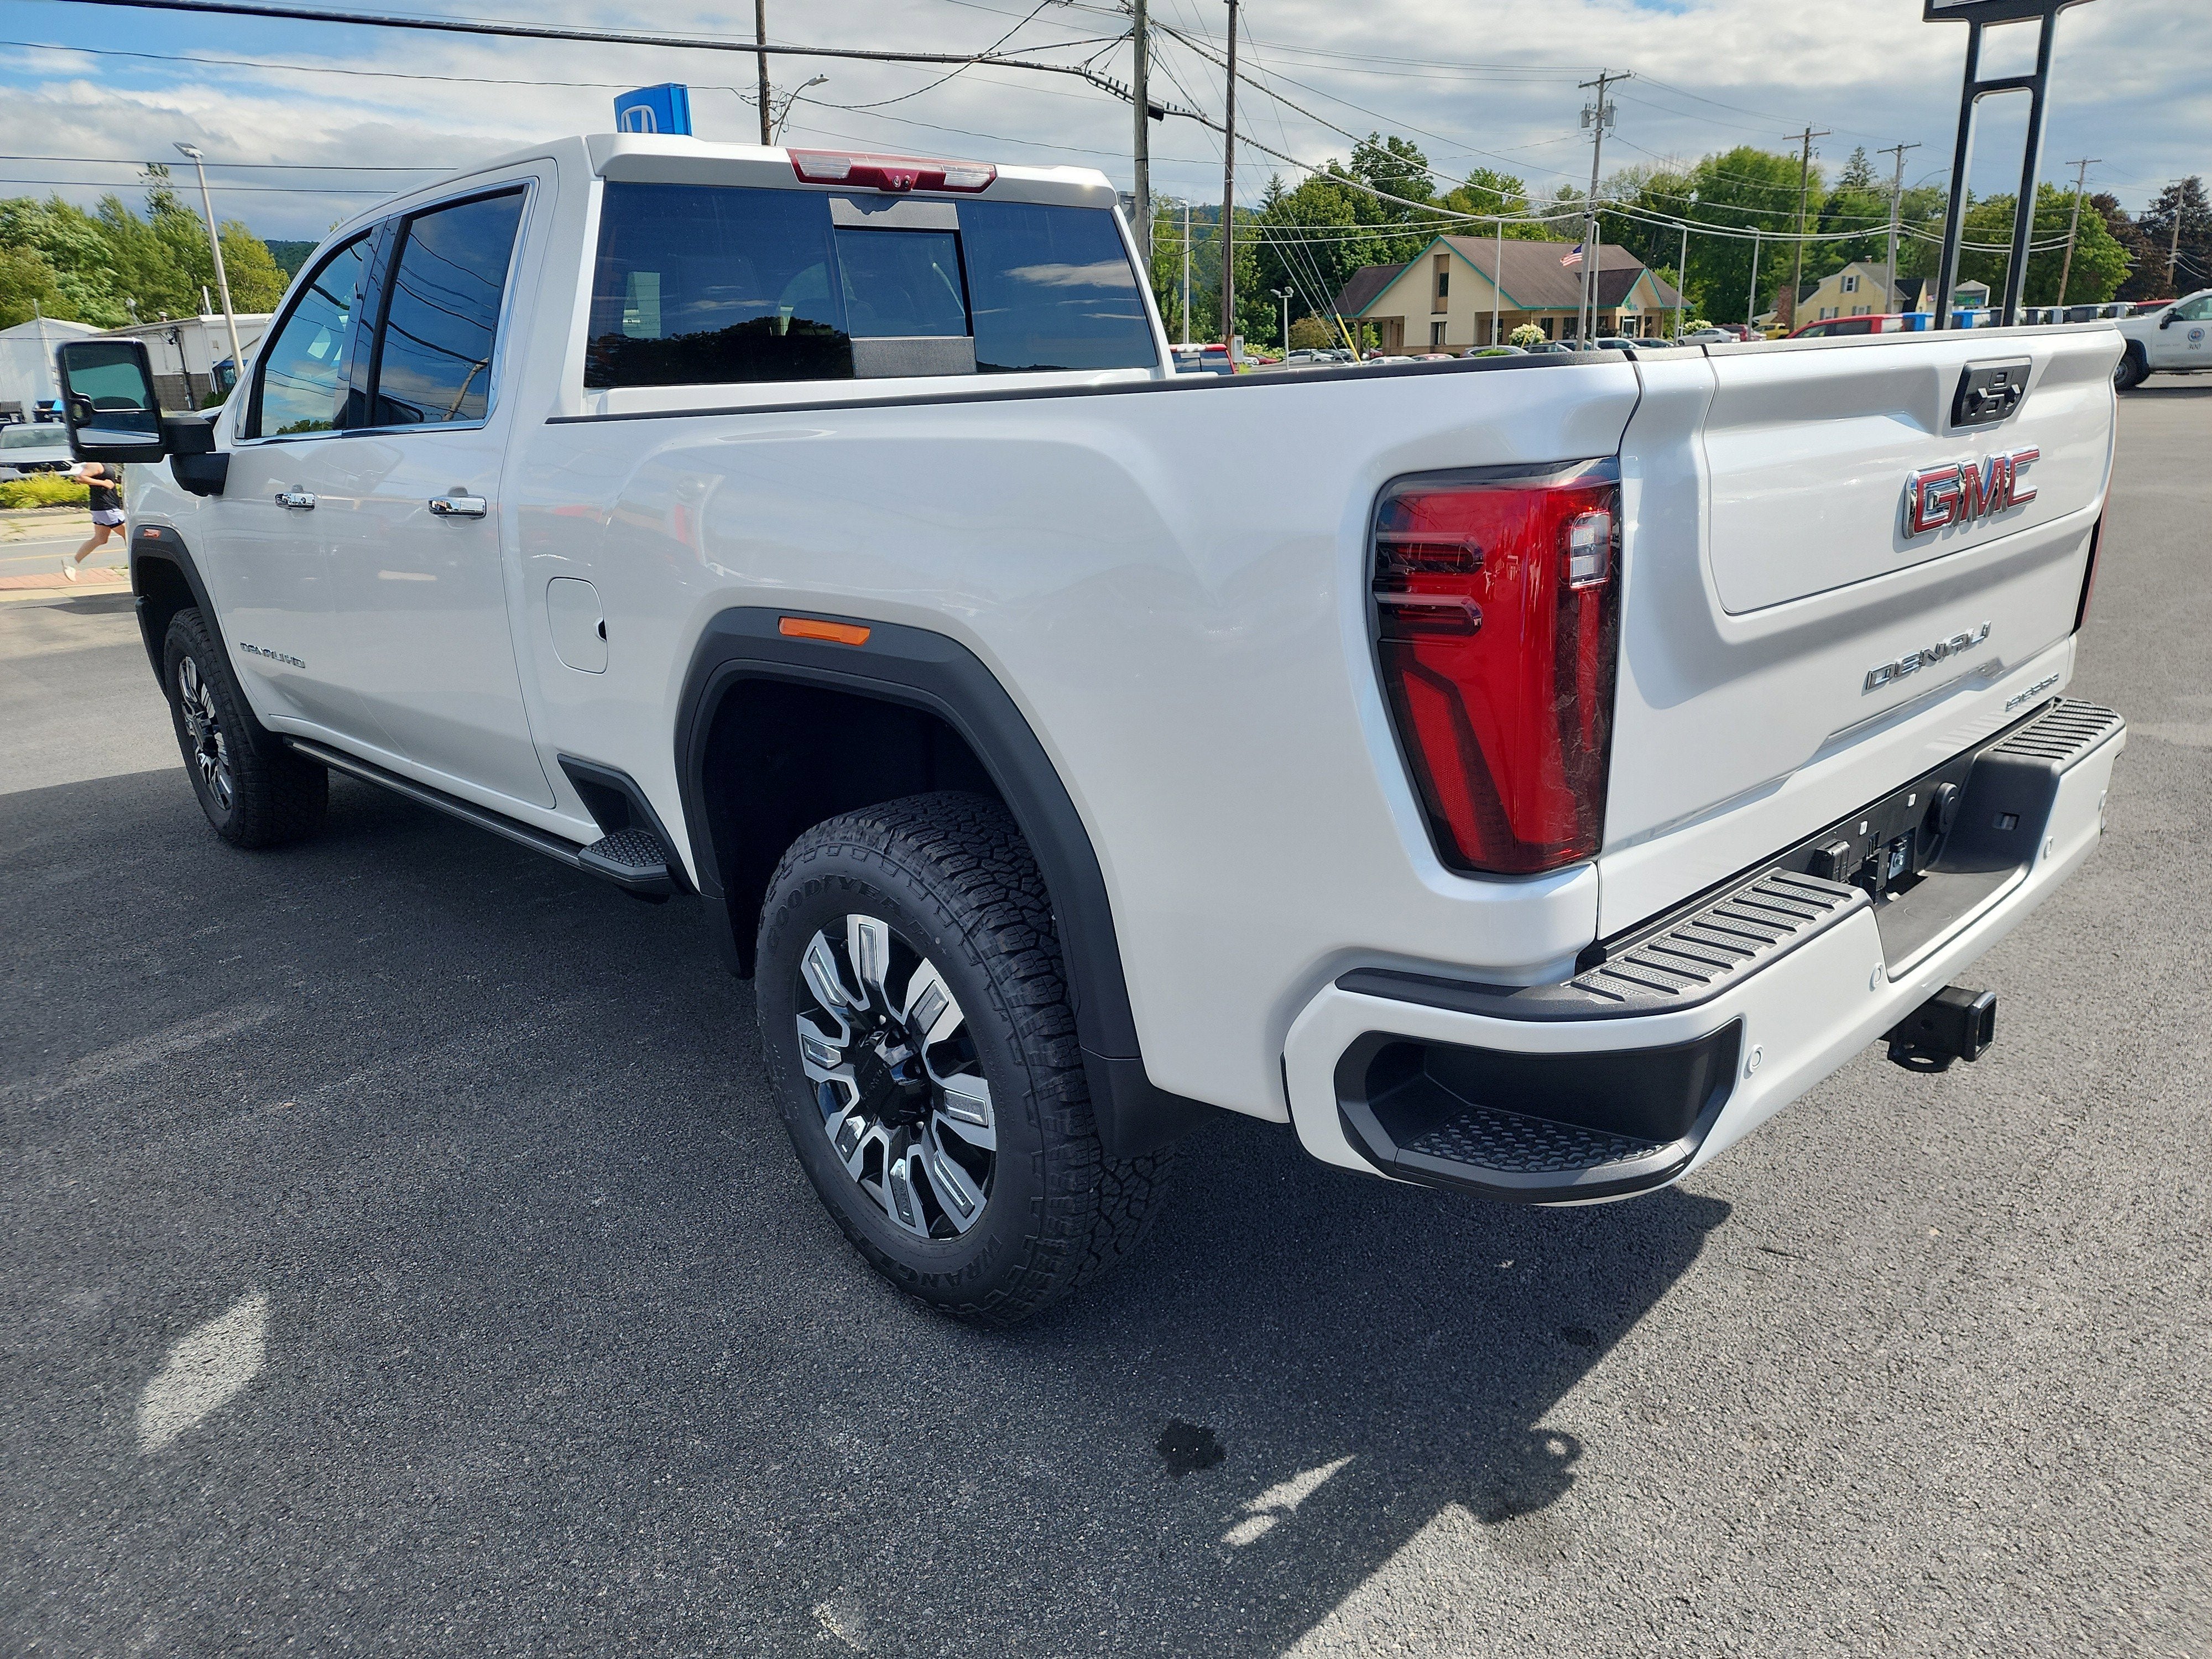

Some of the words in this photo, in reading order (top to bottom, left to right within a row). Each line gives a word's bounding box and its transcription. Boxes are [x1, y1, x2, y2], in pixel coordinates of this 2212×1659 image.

[1902, 444, 2040, 539] GMC
[239, 642, 285, 662] DENALI
[284, 655, 306, 669] HD
[1866, 620, 1991, 690] DENALI
[766, 873, 933, 956] GOODYEAR
